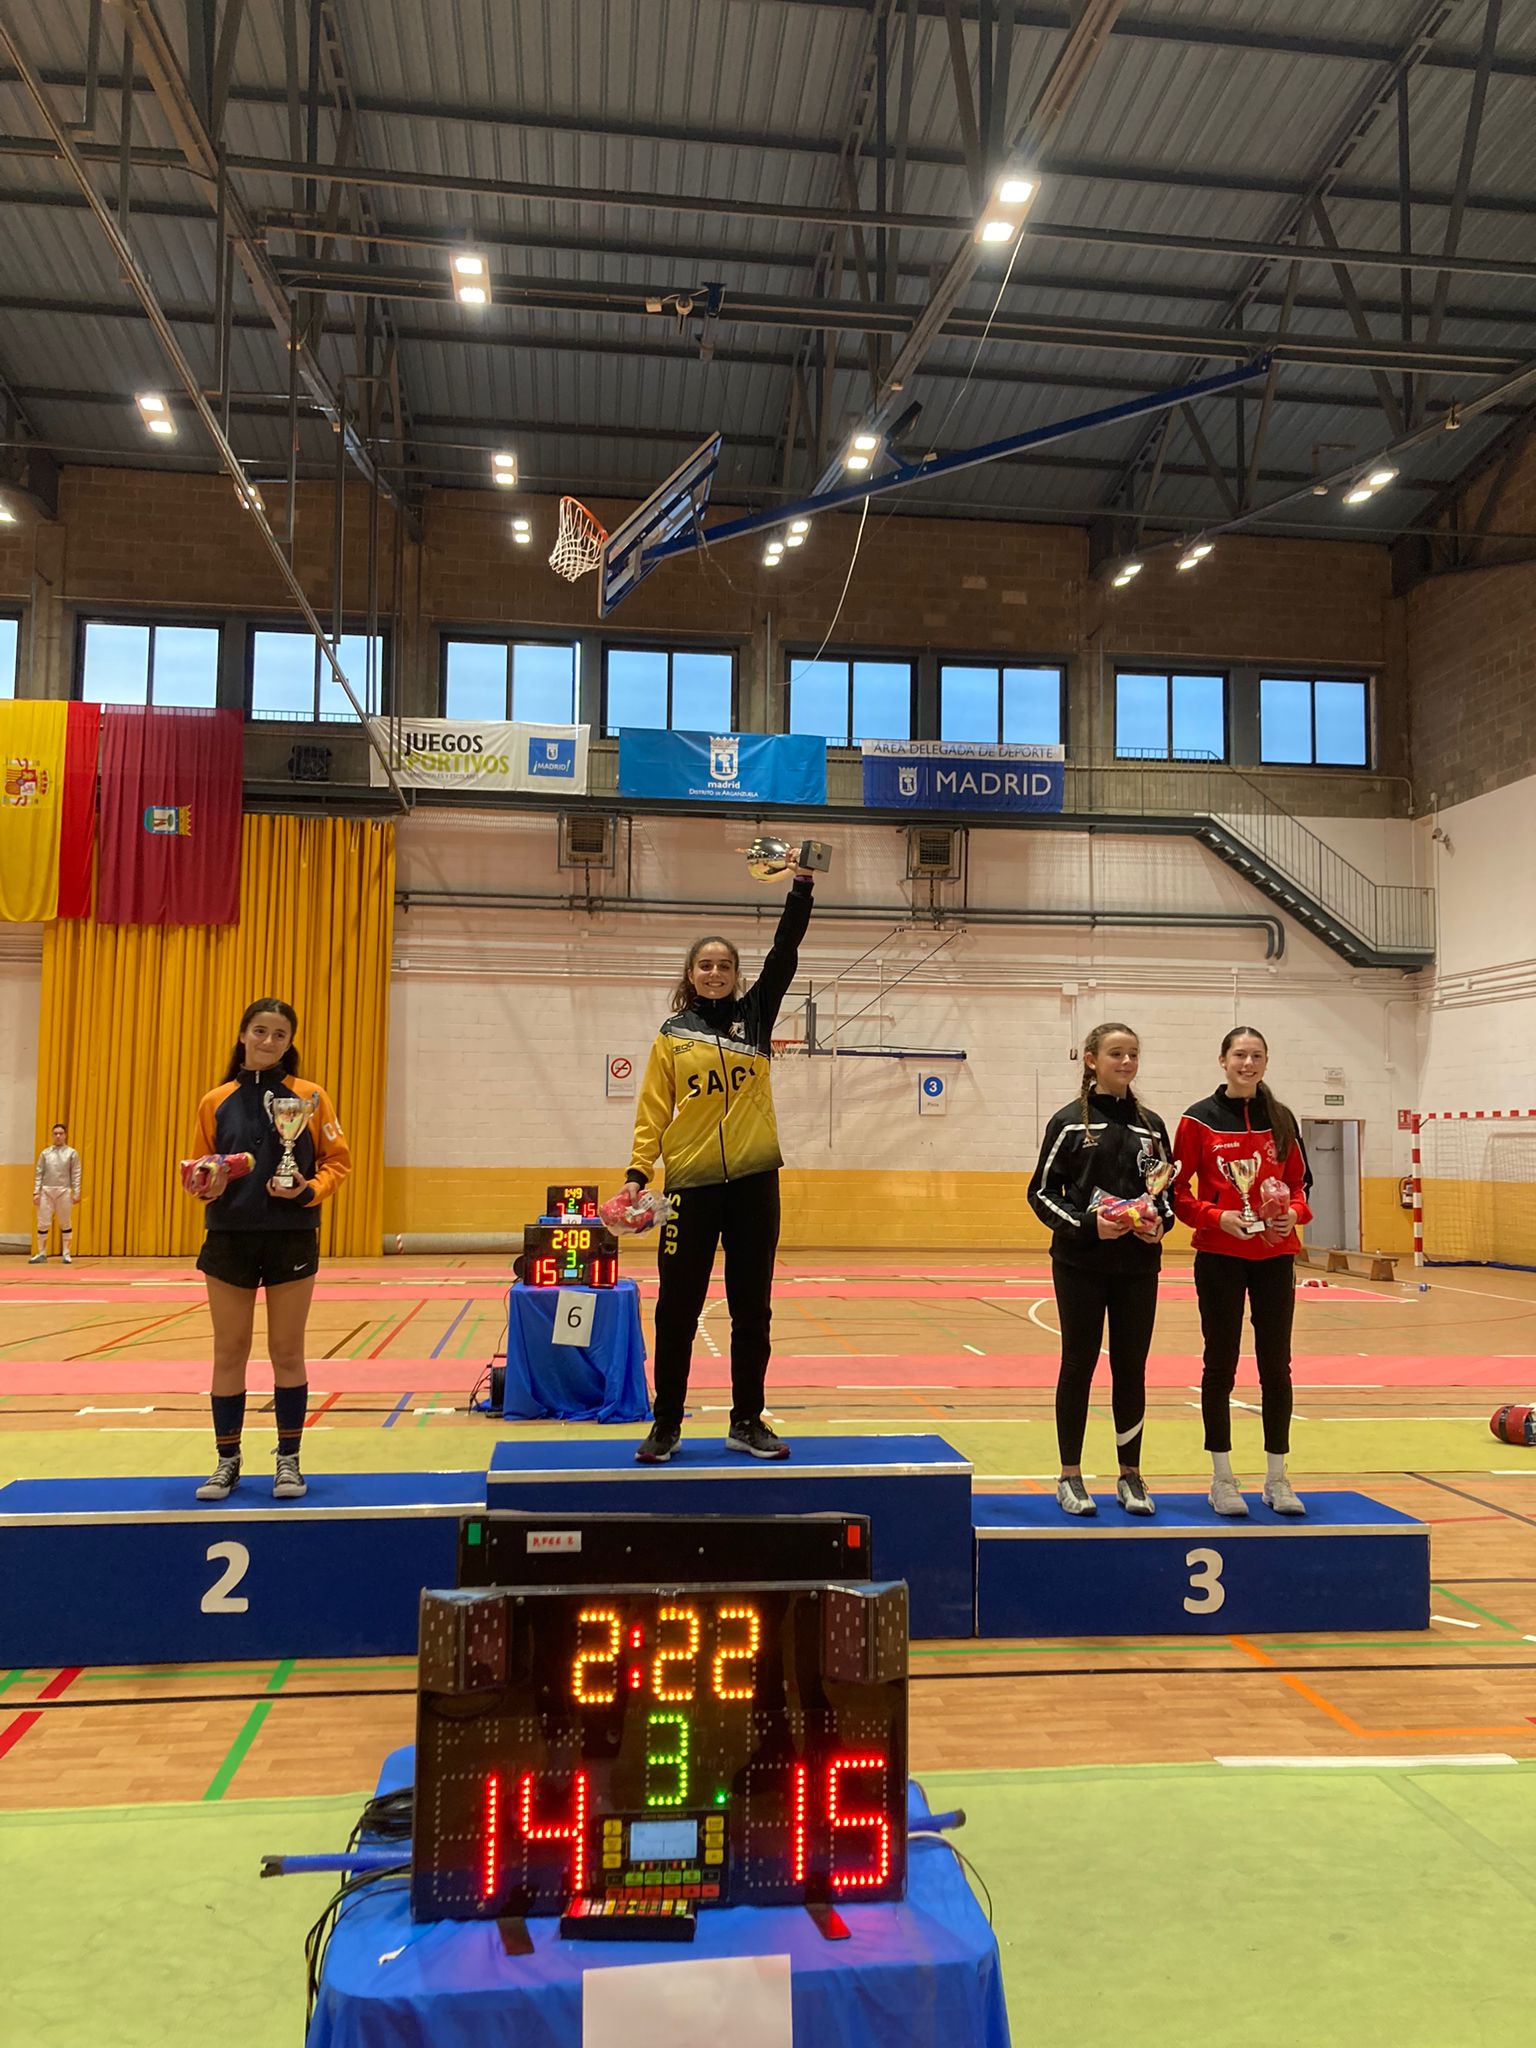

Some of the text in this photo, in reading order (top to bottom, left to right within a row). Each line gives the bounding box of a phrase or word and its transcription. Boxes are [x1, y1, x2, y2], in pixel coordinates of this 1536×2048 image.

[405, 732, 483, 756] JUEGOS
[909, 744, 974, 757] DELEGADA
[978, 746, 996, 758] DE
[998, 746, 1053, 759] DEPORTE
[707, 781, 741, 789] madrid
[936, 770, 1052, 797] MADRID
[687, 1066, 756, 1098] SAG
[929, 1081, 938, 1092] 3
[556, 1202, 565, 1216] 7
[568, 1198, 575, 1209] 2
[583, 1202, 596, 1217] 15
[552, 1230, 591, 1249] 2:08
[566, 1249, 577, 1269] 3
[535, 1258, 557, 1285] 15
[567, 1306, 583, 1328] 6
[200, 1541, 250, 1613] 2
[1183, 1548, 1226, 1614] 3
[573, 1607, 760, 1704] 2:22
[648, 1712, 689, 1807] 3
[483, 1770, 588, 1896] 14
[793, 1757, 888, 1888] 15
